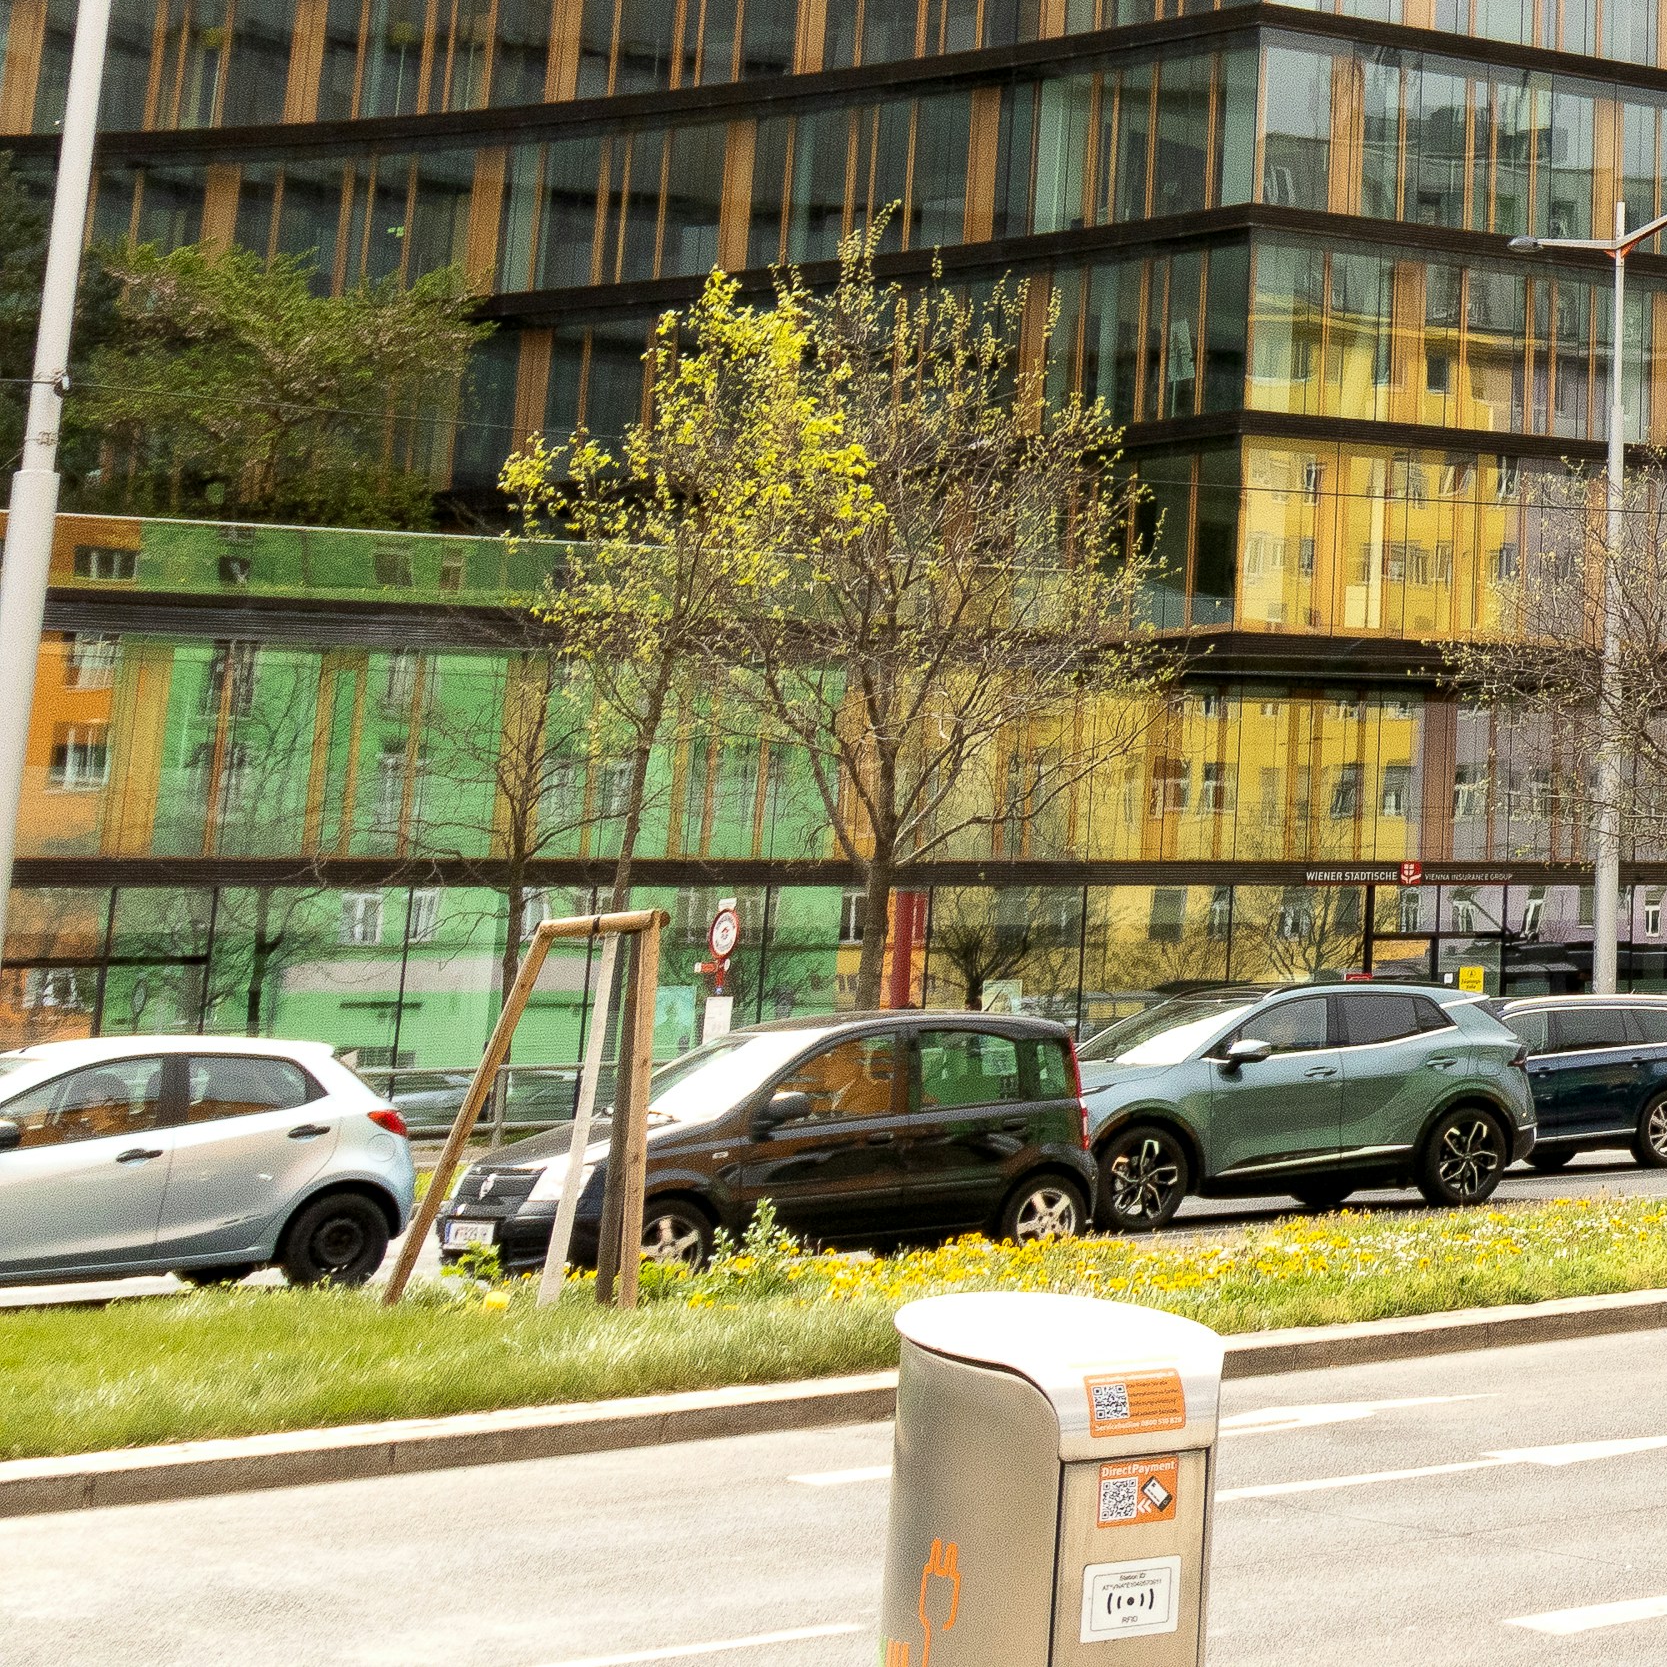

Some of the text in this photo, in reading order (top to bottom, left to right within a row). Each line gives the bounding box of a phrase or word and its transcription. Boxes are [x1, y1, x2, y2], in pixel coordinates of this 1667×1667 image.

[1306, 870, 1398, 881] WIENER STÄDTISCHE
[1425, 873, 1513, 881] VIENNA INSURANCE GROUP
[1101, 1461, 1175, 1477] DirectPayment
[1122, 1616, 1138, 1624] RFID
